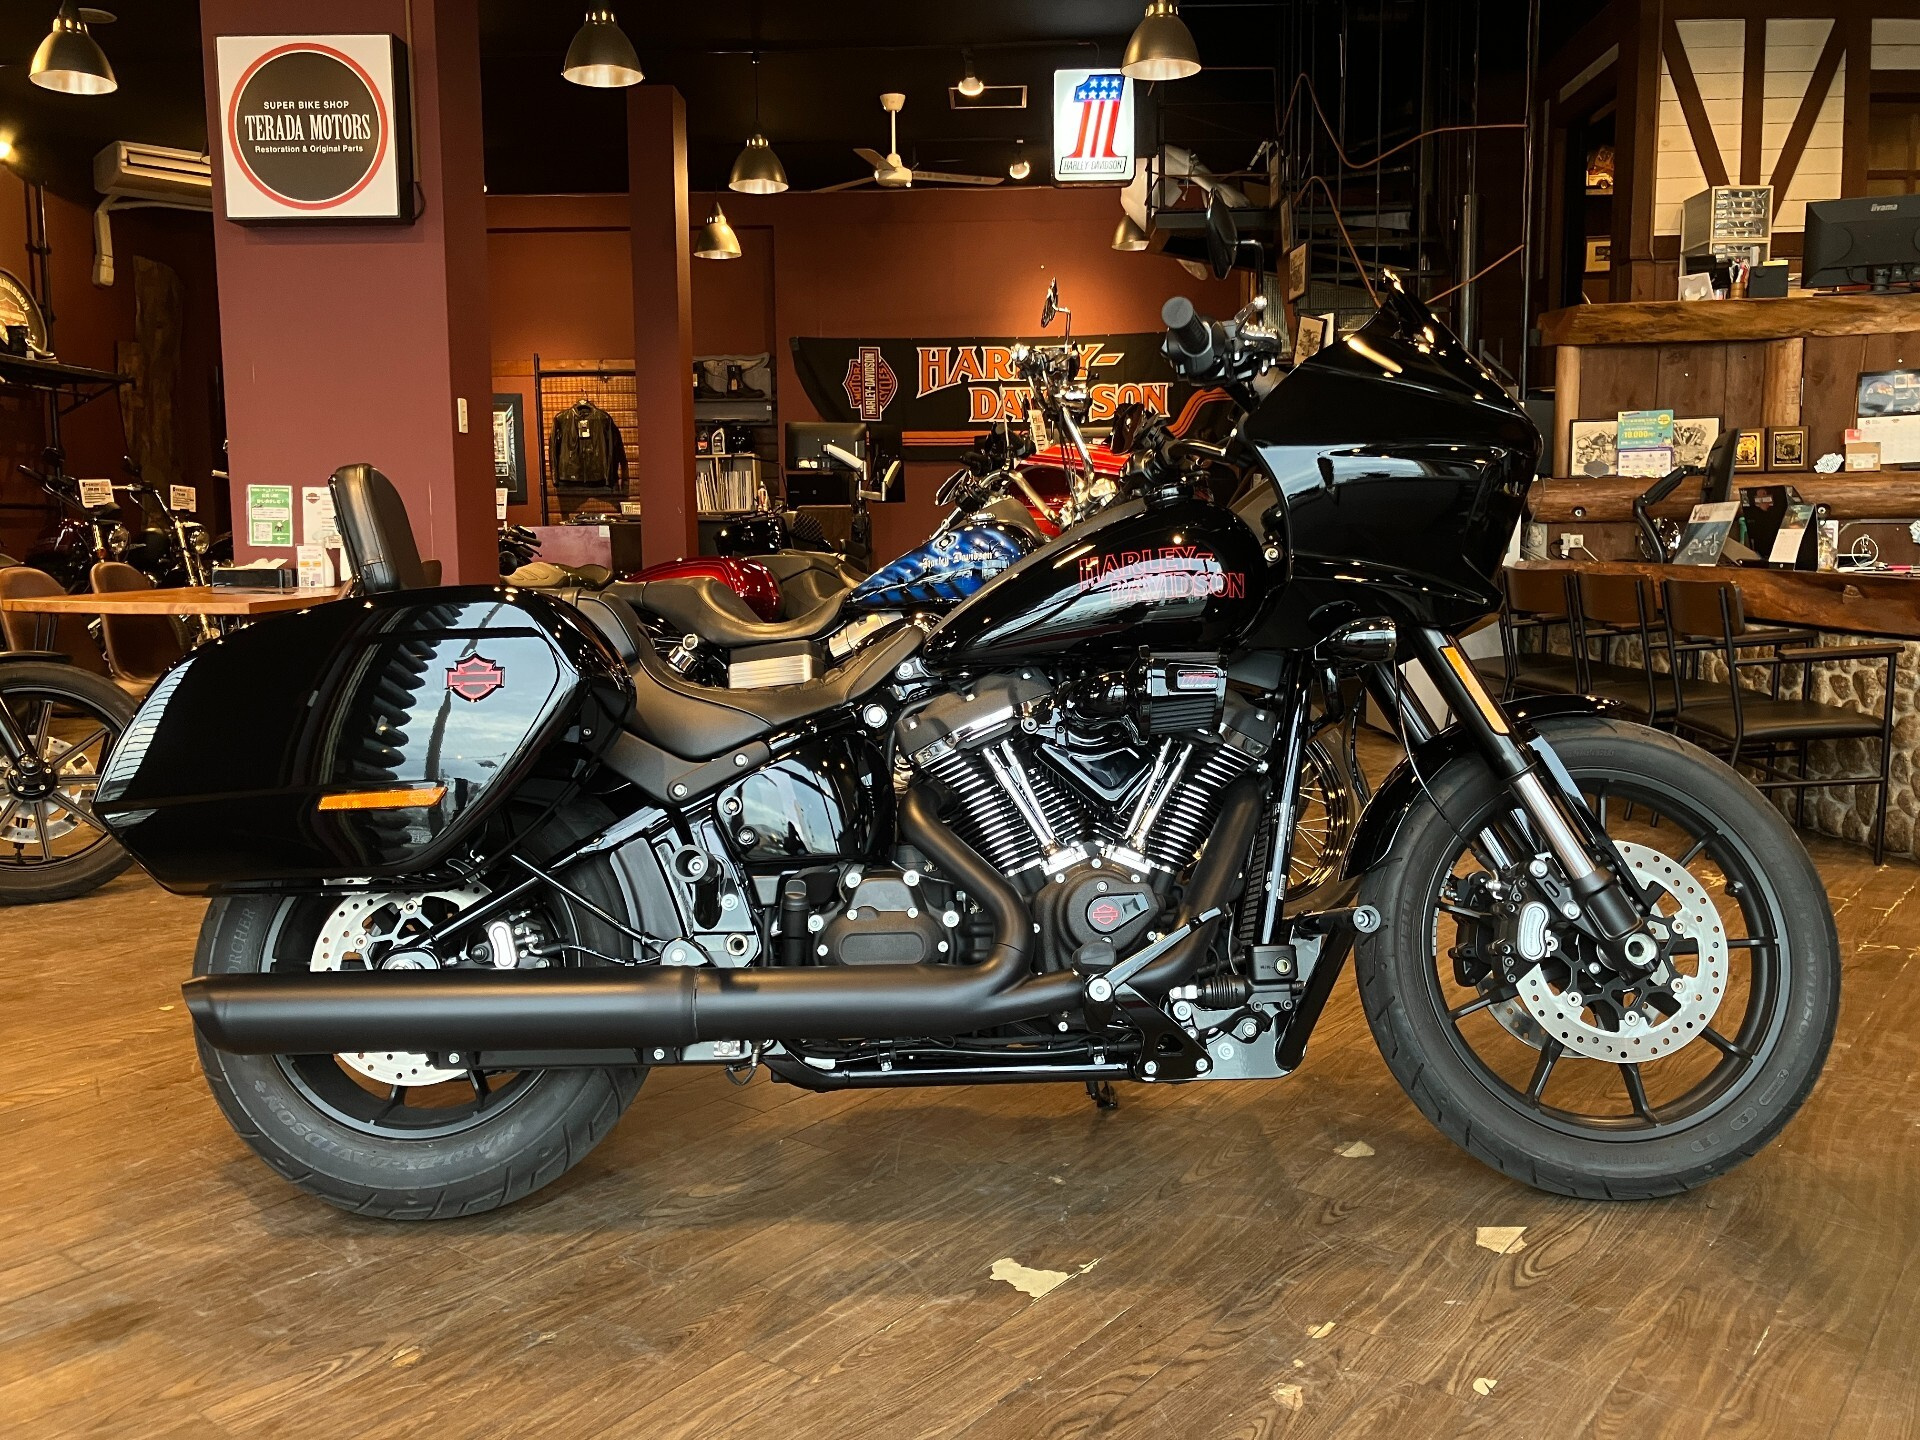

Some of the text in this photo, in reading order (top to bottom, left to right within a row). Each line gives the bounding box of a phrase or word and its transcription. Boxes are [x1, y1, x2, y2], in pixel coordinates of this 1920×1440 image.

[263, 100, 350, 110] SUPER BIKE SHOP
[244, 113, 371, 141] TERADA MOTORS
[254, 144, 363, 154] Restoration & Original Parts
[849, 367, 861, 400] MOTOR
[864, 352, 877, 415] HARLEY-DAVIDSON
[879, 367, 893, 401] CYCLES
[916, 343, 1125, 399] HARY-
[968, 382, 1172, 423] DAVSON
[1079, 546, 1213, 591] HARLEY-
[1110, 571, 1245, 604] DAVIDSON
